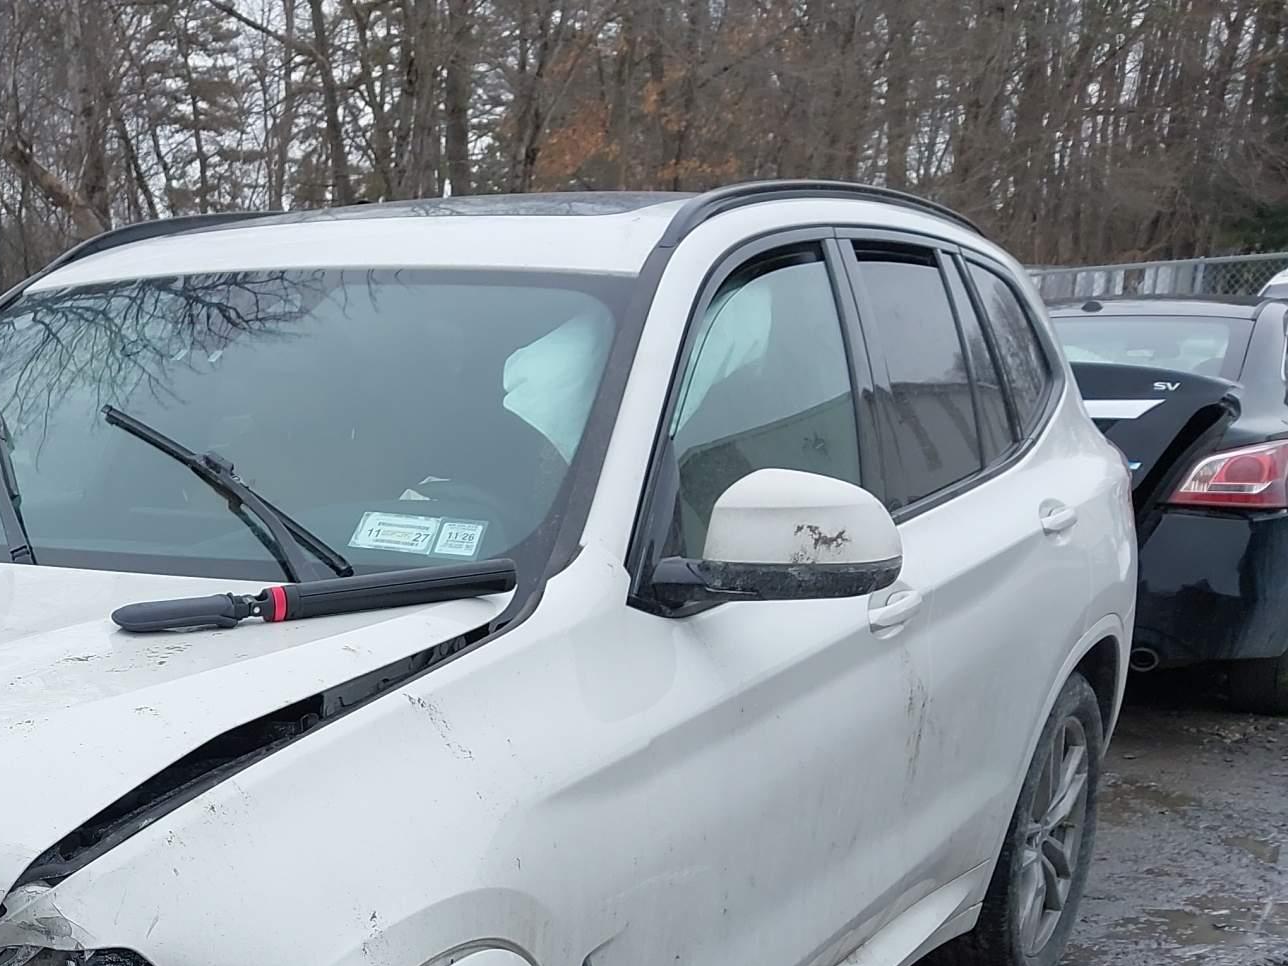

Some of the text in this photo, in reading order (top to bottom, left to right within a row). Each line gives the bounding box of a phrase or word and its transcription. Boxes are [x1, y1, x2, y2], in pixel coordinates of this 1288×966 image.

[1153, 381, 1181, 391] SV
[367, 527, 383, 538] 11
[412, 532, 430, 543] 27
[447, 531, 458, 540] 11
